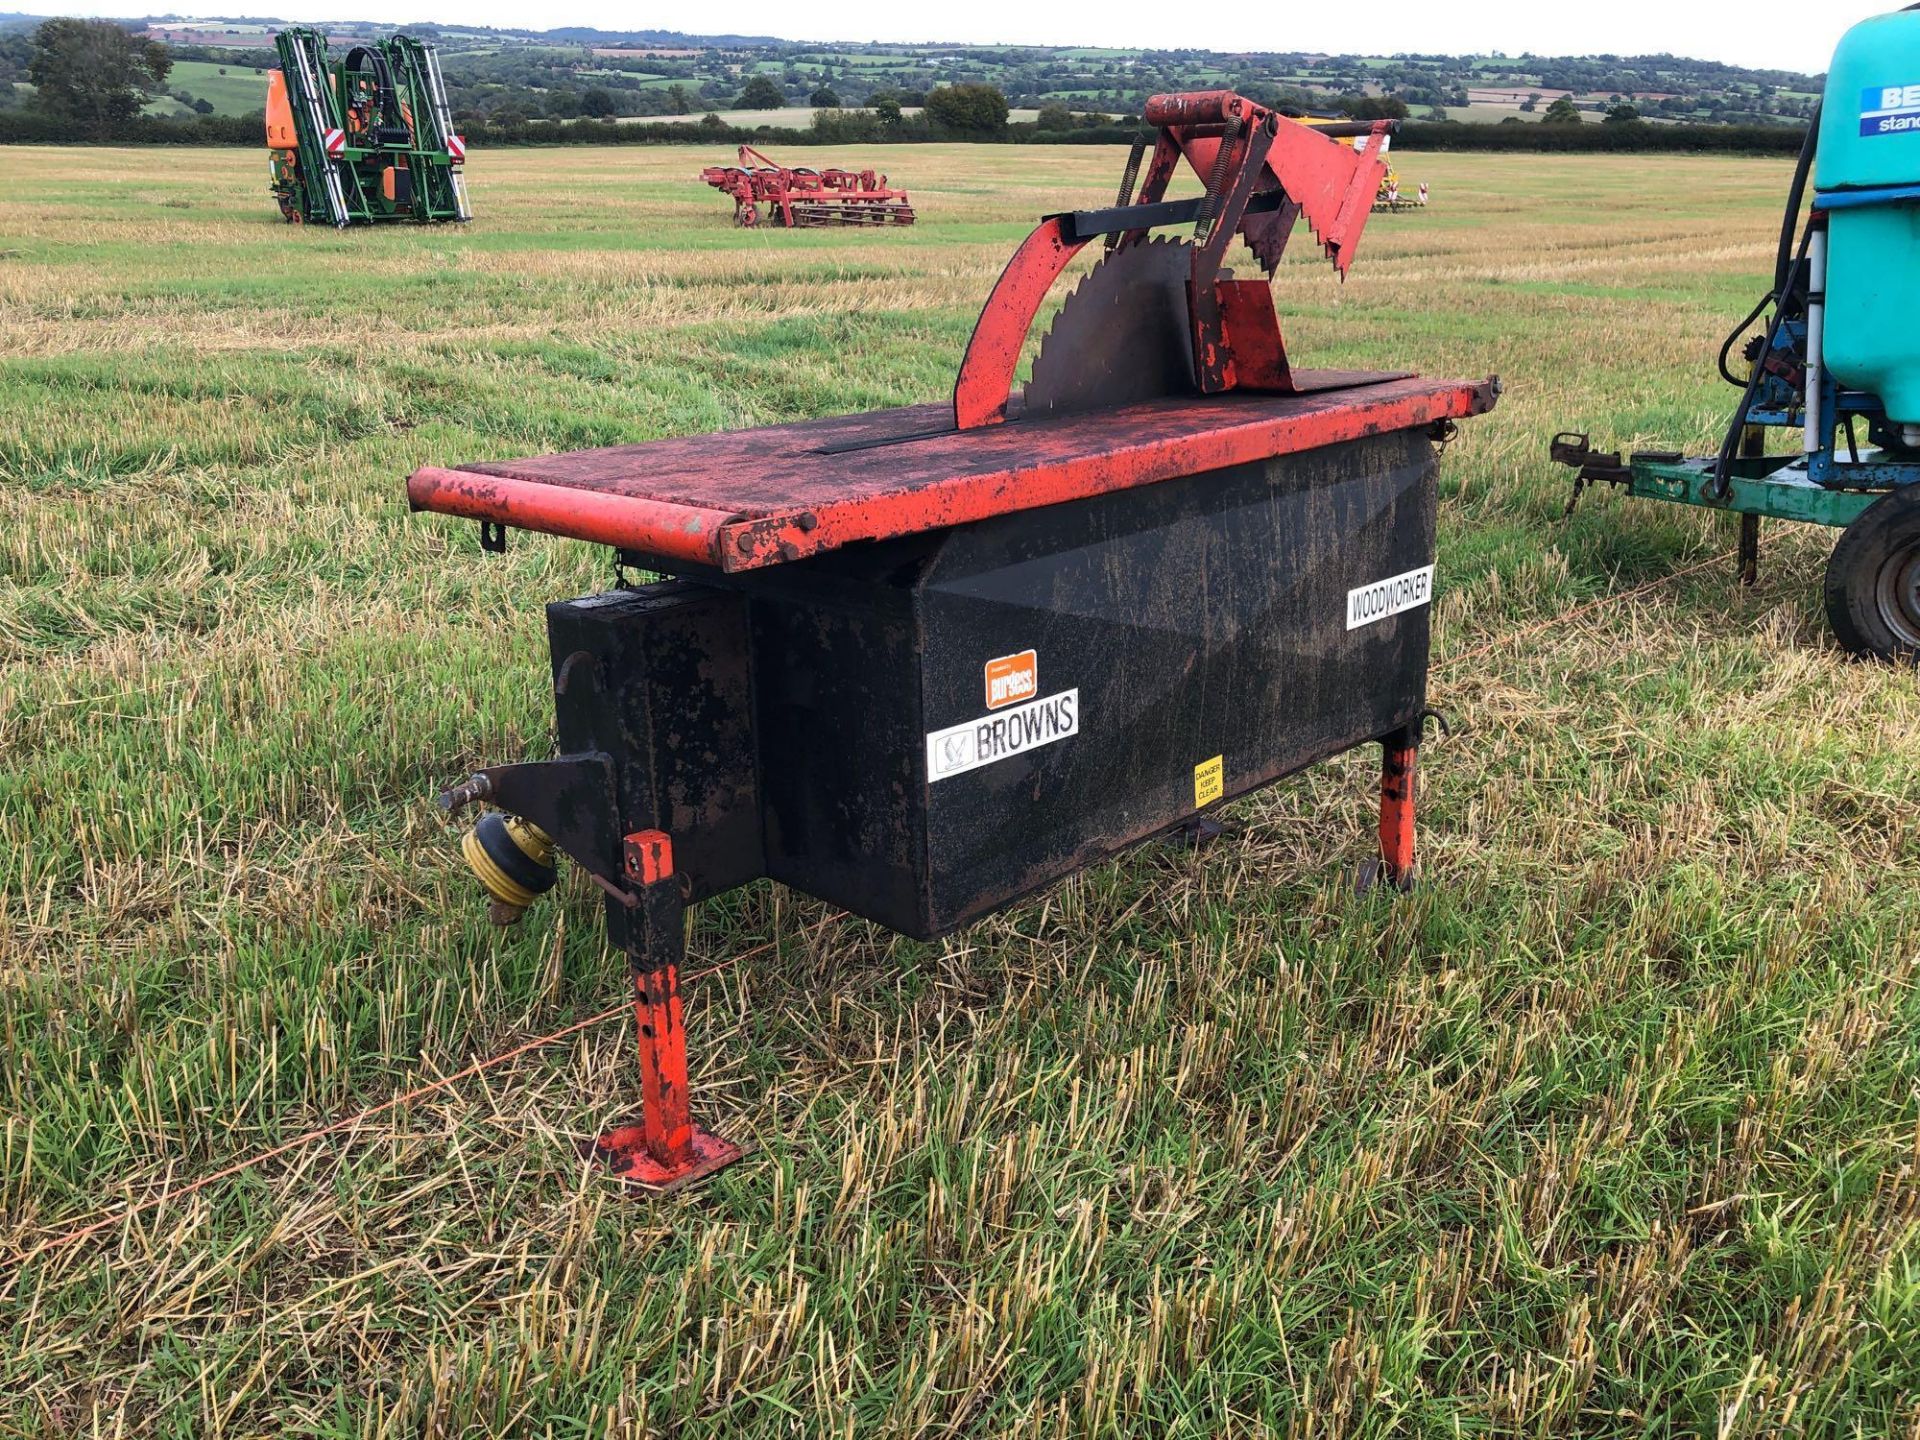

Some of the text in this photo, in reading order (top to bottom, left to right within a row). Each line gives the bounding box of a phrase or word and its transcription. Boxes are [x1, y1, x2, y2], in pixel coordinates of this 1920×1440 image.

[1352, 573, 1427, 621] WOODWORKER
[976, 695, 1073, 760] BROWNS
[1195, 764, 1220, 780] DANGER
[1200, 776, 1216, 789] KEEP
[1199, 785, 1218, 799] CLEAR
